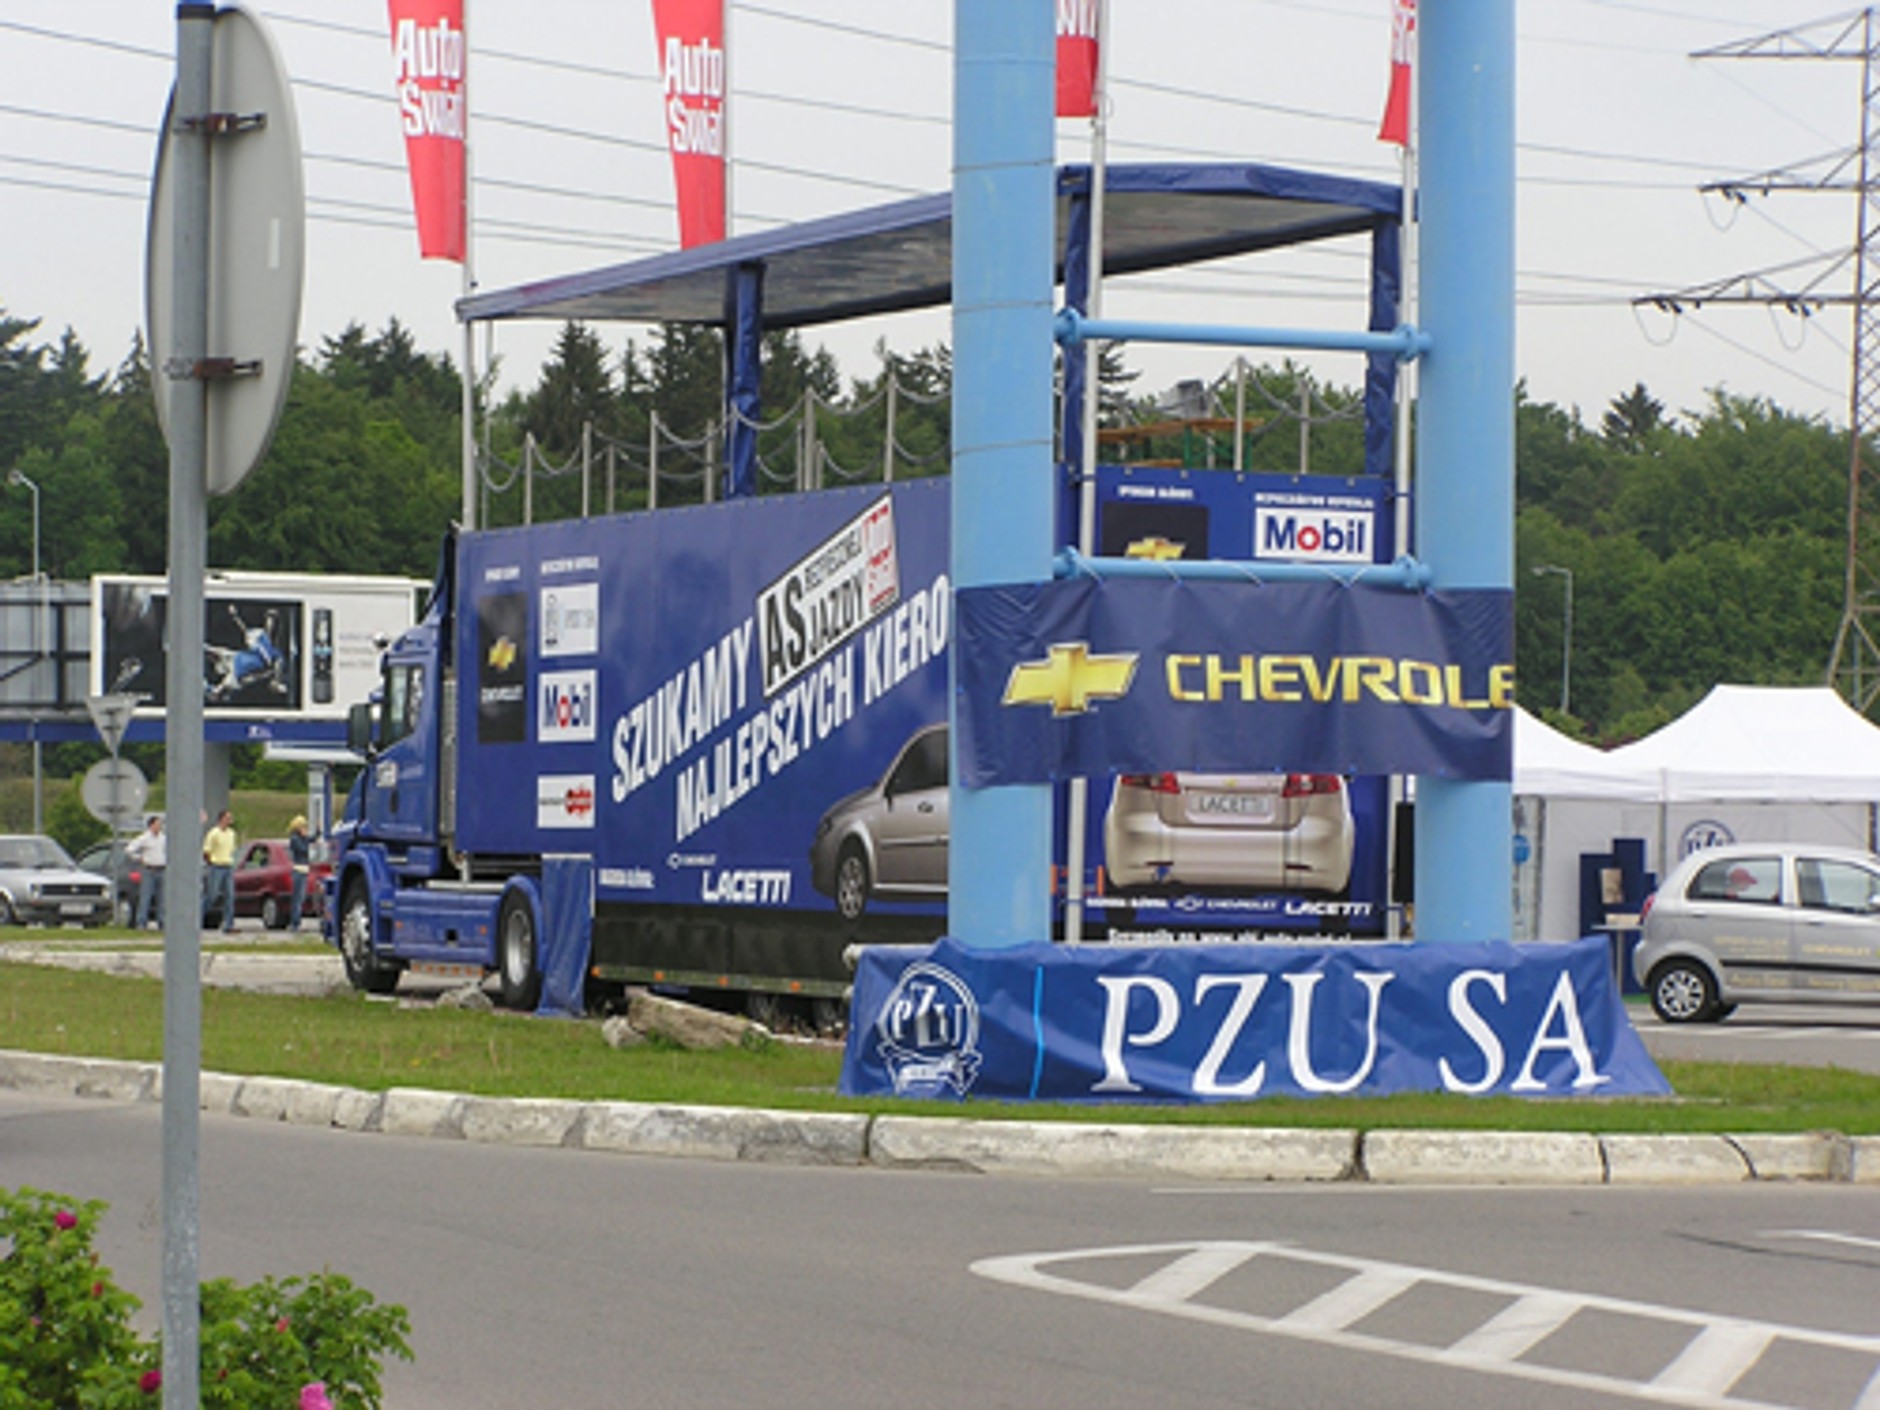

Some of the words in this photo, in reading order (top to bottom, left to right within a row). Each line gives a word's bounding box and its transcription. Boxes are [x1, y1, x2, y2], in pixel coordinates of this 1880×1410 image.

[397, 18, 463, 79] Auto
[664, 36, 724, 97] Auto
[1265, 516, 1366, 553] Mobil
[766, 574, 807, 688] AS
[612, 615, 753, 803] SZUKAMY
[677, 645, 855, 843] NAJLEPSZYCH
[864, 573, 950, 706] KIERO
[702, 869, 793, 904] LACETTI
[1285, 902, 1373, 916] LACETTI
[891, 980, 964, 1048] PZU
[1090, 969, 1396, 1095] PZU
[1438, 969, 1612, 1094] SA
